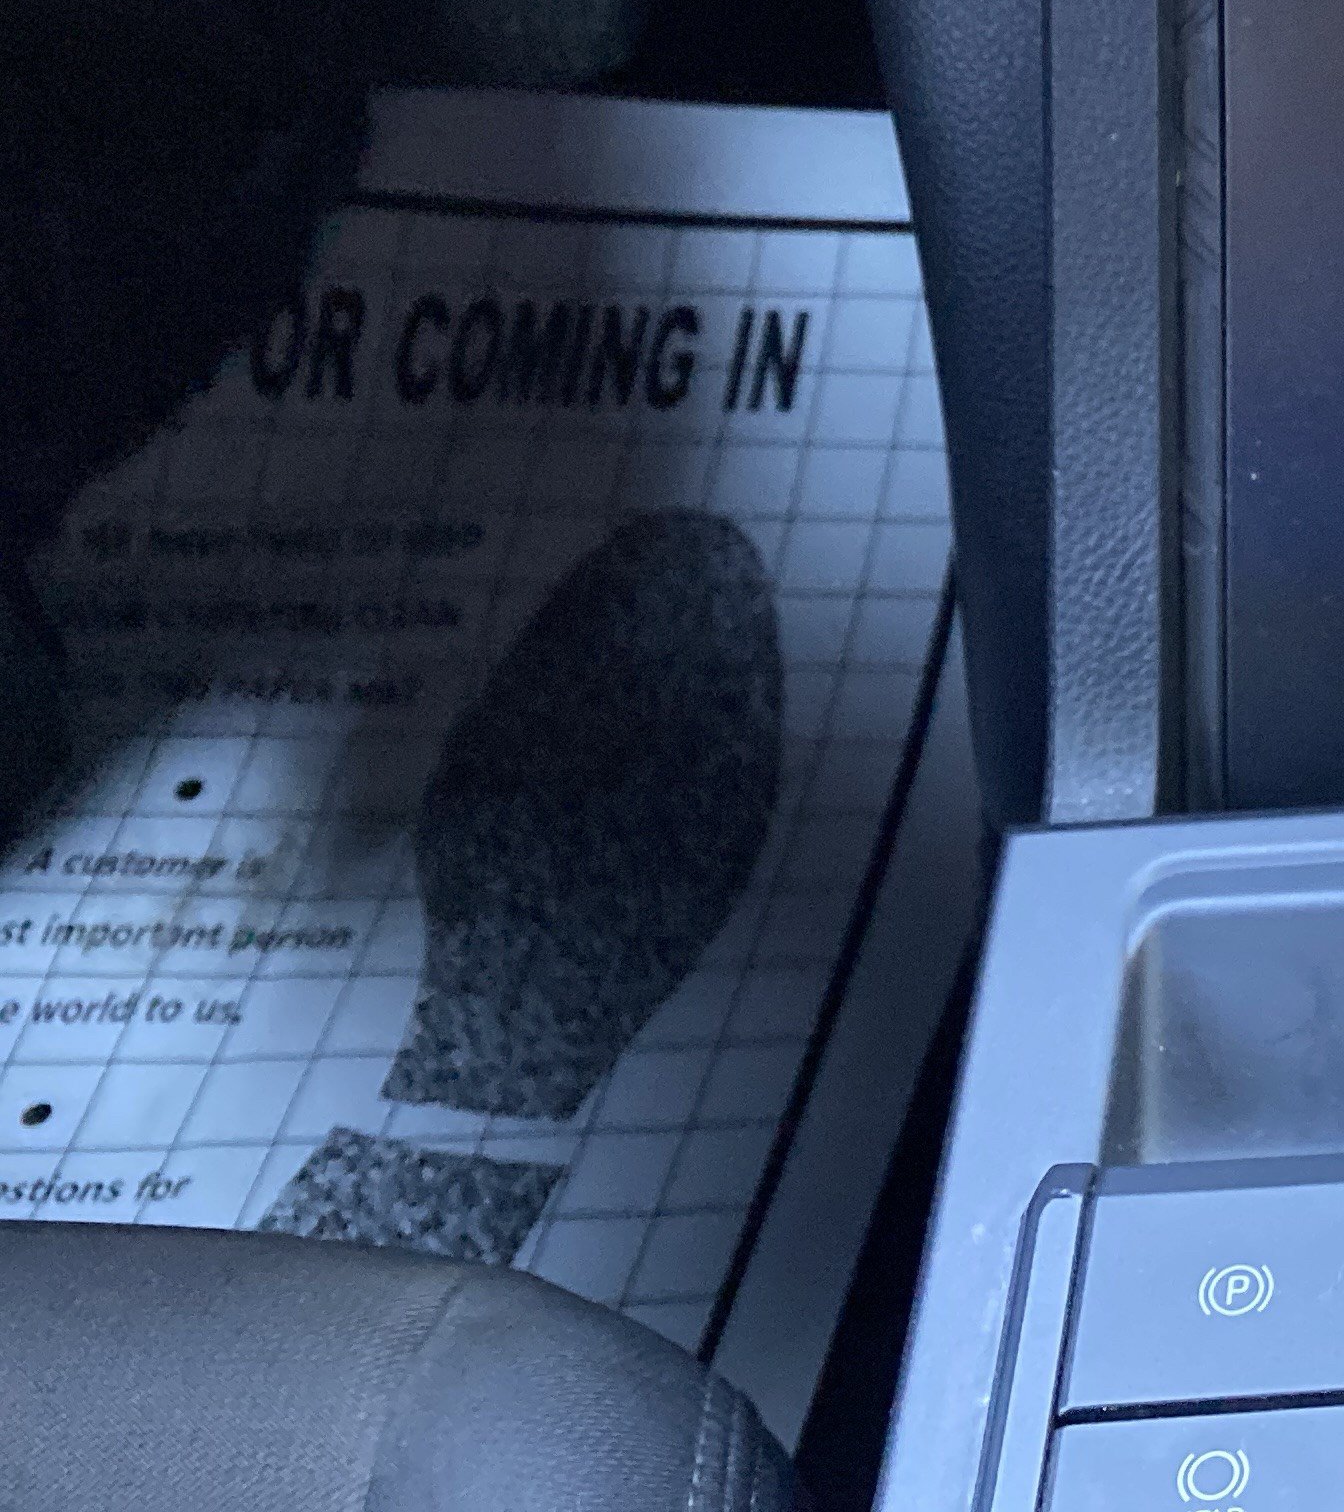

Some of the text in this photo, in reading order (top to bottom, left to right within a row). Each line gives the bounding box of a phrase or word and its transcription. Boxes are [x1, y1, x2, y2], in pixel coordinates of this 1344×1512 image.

[250, 289, 810, 413] OR COMING IN
[40, 913, 224, 957] important
[32, 992, 140, 1025] world
[145, 994, 184, 1024] to
[0, 1171, 192, 1205] stions for
